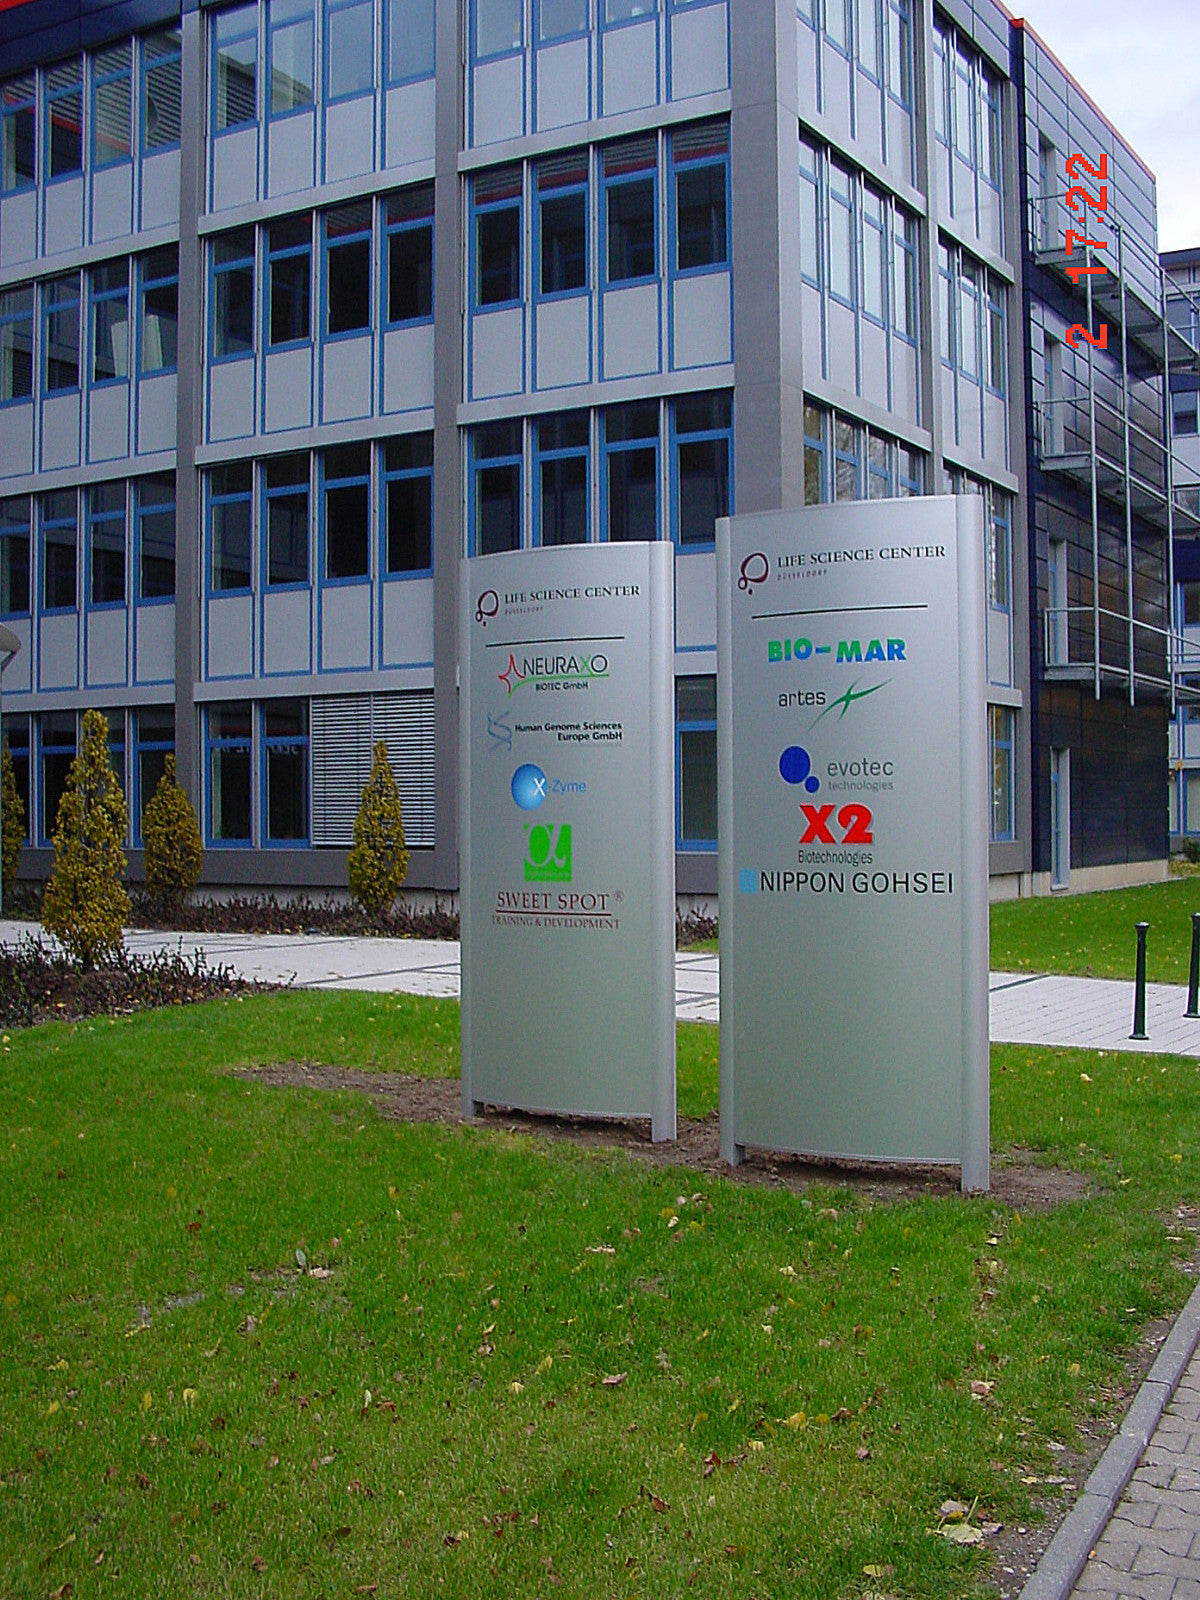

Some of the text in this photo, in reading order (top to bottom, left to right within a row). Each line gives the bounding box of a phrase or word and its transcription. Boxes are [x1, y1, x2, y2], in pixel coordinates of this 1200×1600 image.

[777, 545, 946, 569] LIFE SCIENCE CENTER
[504, 585, 640, 604] LIFE SCIENCE CENTER
[768, 637, 906, 663] BIO-MAR
[563, 681, 589, 690] GmbH
[778, 690, 826, 707] artes
[515, 720, 622, 732] Human Genome Sciences
[558, 731, 623, 742] Europe GmbH
[827, 758, 894, 777] evotec
[828, 780, 894, 792] technologies
[799, 803, 873, 844] X2
[798, 850, 873, 867] Biotechnologies
[760, 871, 953, 894] NIPPON GOHSEI
[497, 891, 551, 910] SWEET
[492, 914, 533, 927] TRAINING
[544, 917, 621, 930] DEVELOPMENT
